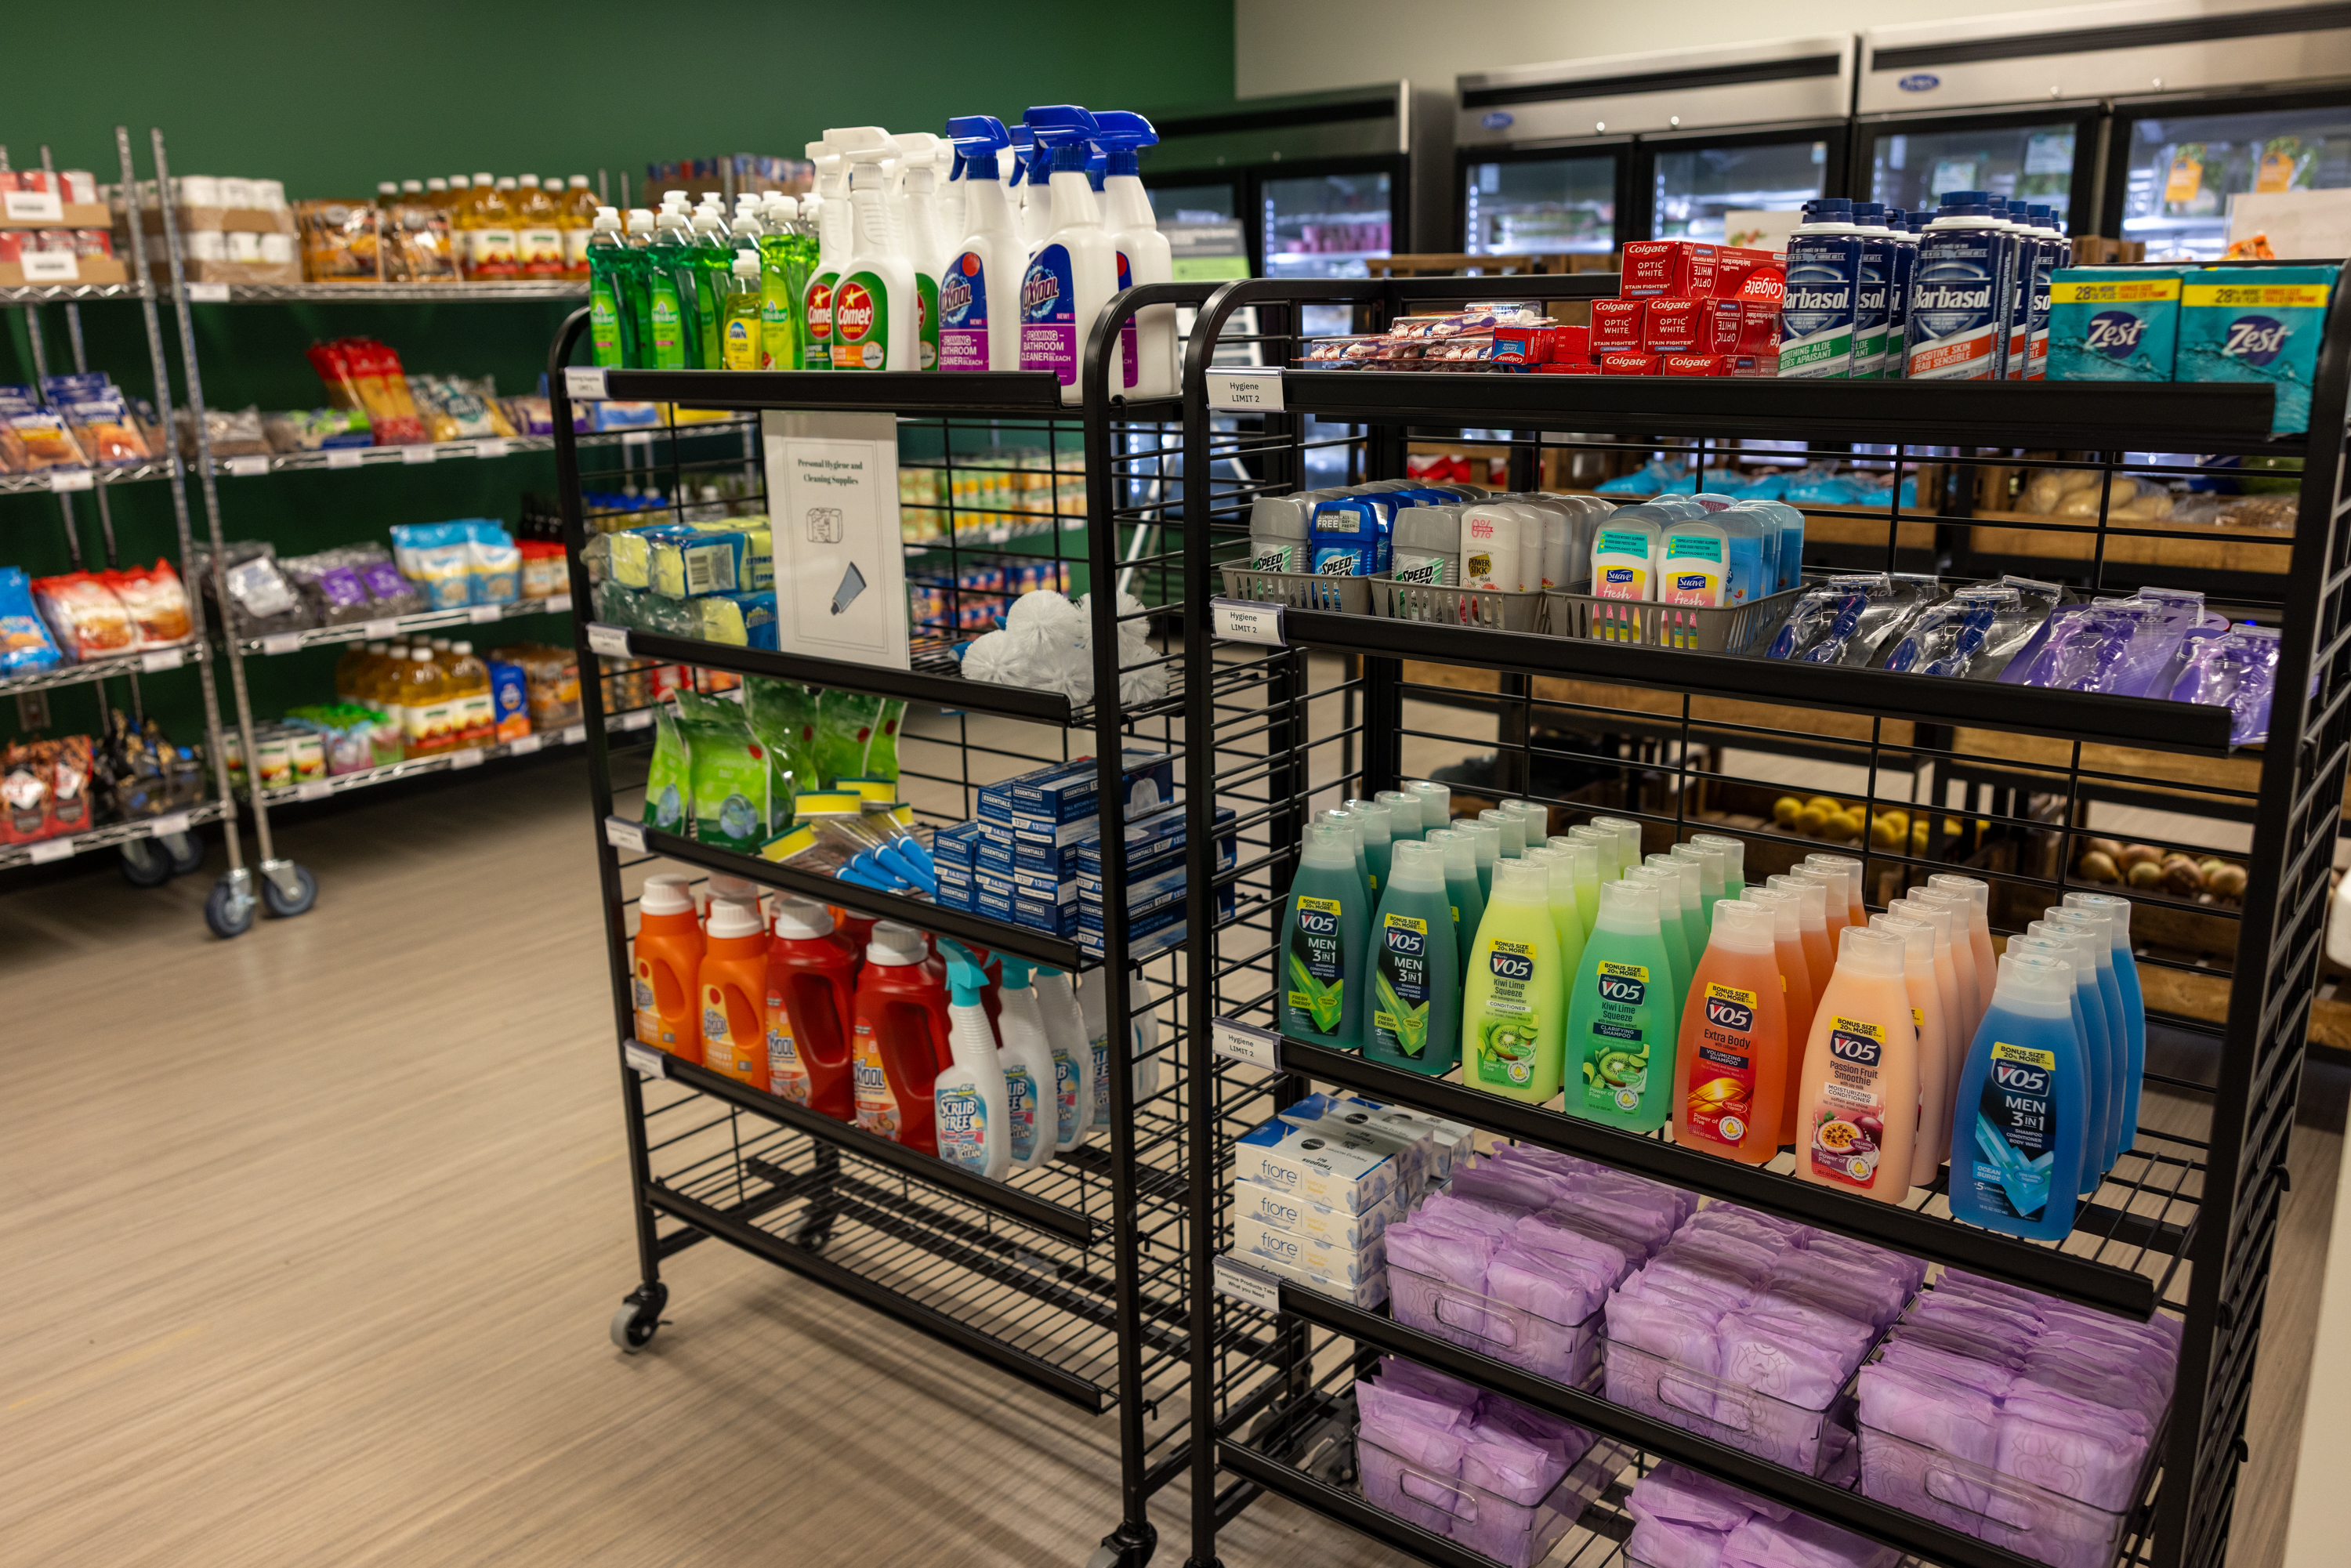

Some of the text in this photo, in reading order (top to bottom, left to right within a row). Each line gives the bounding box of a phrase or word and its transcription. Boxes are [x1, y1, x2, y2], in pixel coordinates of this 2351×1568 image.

[1629, 245, 1668, 255] Colgate
[1694, 266, 1712, 276] WHITE
[1694, 277, 1712, 287] OPTIC
[1744, 277, 1783, 295] Colgate
[1782, 287, 1849, 309] Barbasol
[1914, 285, 1991, 309] Barbasol
[1596, 302, 1633, 312] Colgate
[1652, 301, 1690, 310] Colgate
[838, 306, 871, 324] Comet
[730, 330, 746, 339] DAWN
[944, 335, 971, 346] FOAMING
[1027, 331, 1057, 341] FOAMING
[2084, 320, 2148, 349] Zest
[2222, 324, 2294, 355] Zest
[942, 346, 976, 355] BATHROOM
[1023, 342, 1063, 350] BATHROOM
[1781, 342, 1831, 361] SOOTHING ALOE
[1796, 349, 1831, 364] APAISANT
[1915, 342, 1971, 363] SENSITIVE SKIN
[1607, 357, 1646, 366] Colgate
[1670, 357, 1710, 367] Colgate
[1914, 351, 1970, 372] PEAU SENSIBLE
[1230, 382, 1259, 391] Hygiene
[798, 458, 824, 467] Personal
[825, 460, 849, 469] Hygiene
[804, 474, 858, 486] Cleaning Supplies
[1317, 520, 1339, 529] FREE
[1257, 553, 1284, 569] SPEED
[1321, 556, 1352, 574] SPEED
[1469, 559, 1490, 567] POWER
[1402, 567, 1433, 581] SPEED
[1607, 570, 1632, 581] Suave
[1679, 577, 1704, 588] Suave
[1603, 585, 1632, 599] fresh
[1675, 592, 1705, 604] fresh
[1230, 612, 1257, 621] Hygiene
[1231, 624, 1250, 632] LIMIT
[1014, 788, 1040, 798] ESSENTIALS
[1064, 785, 1089, 798] ESSENTIALS
[984, 795, 1011, 807] ESSENTIALS
[1018, 846, 1043, 856] ESSENTIALS
[1128, 847, 1152, 860] ESSENTIALS
[1301, 915, 1335, 932] VO5
[1308, 937, 1335, 950] MEN
[1388, 932, 1422, 951] VO5
[1395, 957, 1422, 970] MEN
[1493, 958, 1530, 976] VO5
[1494, 979, 1524, 990] Kiwi Lime
[1602, 981, 1642, 1000] VO5
[1495, 987, 1522, 998] Squeeze
[1490, 1001, 1526, 1011] CONDITIONER
[1618, 1005, 1635, 1014] Lime
[1603, 1012, 1632, 1022] Squeeze
[1710, 1005, 1750, 1024] VO5
[1838, 1018, 1860, 1028] BONUS
[1601, 1025, 1633, 1034] CLARIFYING
[1853, 1027, 1873, 1036] MORE
[1229, 1034, 1253, 1047] Hygiene
[1704, 1029, 1750, 1049] Extra Body
[1230, 1045, 1248, 1055] LIMIT
[1835, 1038, 1878, 1060] VO5
[2001, 1046, 2026, 1056] BONUS
[1707, 1049, 1741, 1062] VOLUMIZING
[1710, 1055, 1737, 1066] SHAMPOO
[1831, 1060, 1878, 1079] Passion Fruit
[1835, 1070, 1871, 1085] Smoothie
[1998, 1066, 2046, 1089] VO5
[1828, 1085, 1871, 1099] MOISTURIZING
[1829, 1090, 1870, 1103] CONDITIONER
[941, 1099, 976, 1115] SCRUB
[2005, 1095, 2045, 1114] MEN
[945, 1116, 969, 1129] FREE
[2006, 1132, 2042, 1143] CONDITIONER
[1819, 1152, 1836, 1161] Power
[1262, 1160, 1298, 1183] fiore
[1977, 1166, 2001, 1175] OCEAN
[1977, 1171, 2001, 1181] SURGE
[1261, 1197, 1298, 1220] fiore
[1262, 1233, 1298, 1255] fiore
[1218, 1270, 1238, 1281] Feminine
[1241, 1279, 1262, 1291] Products
